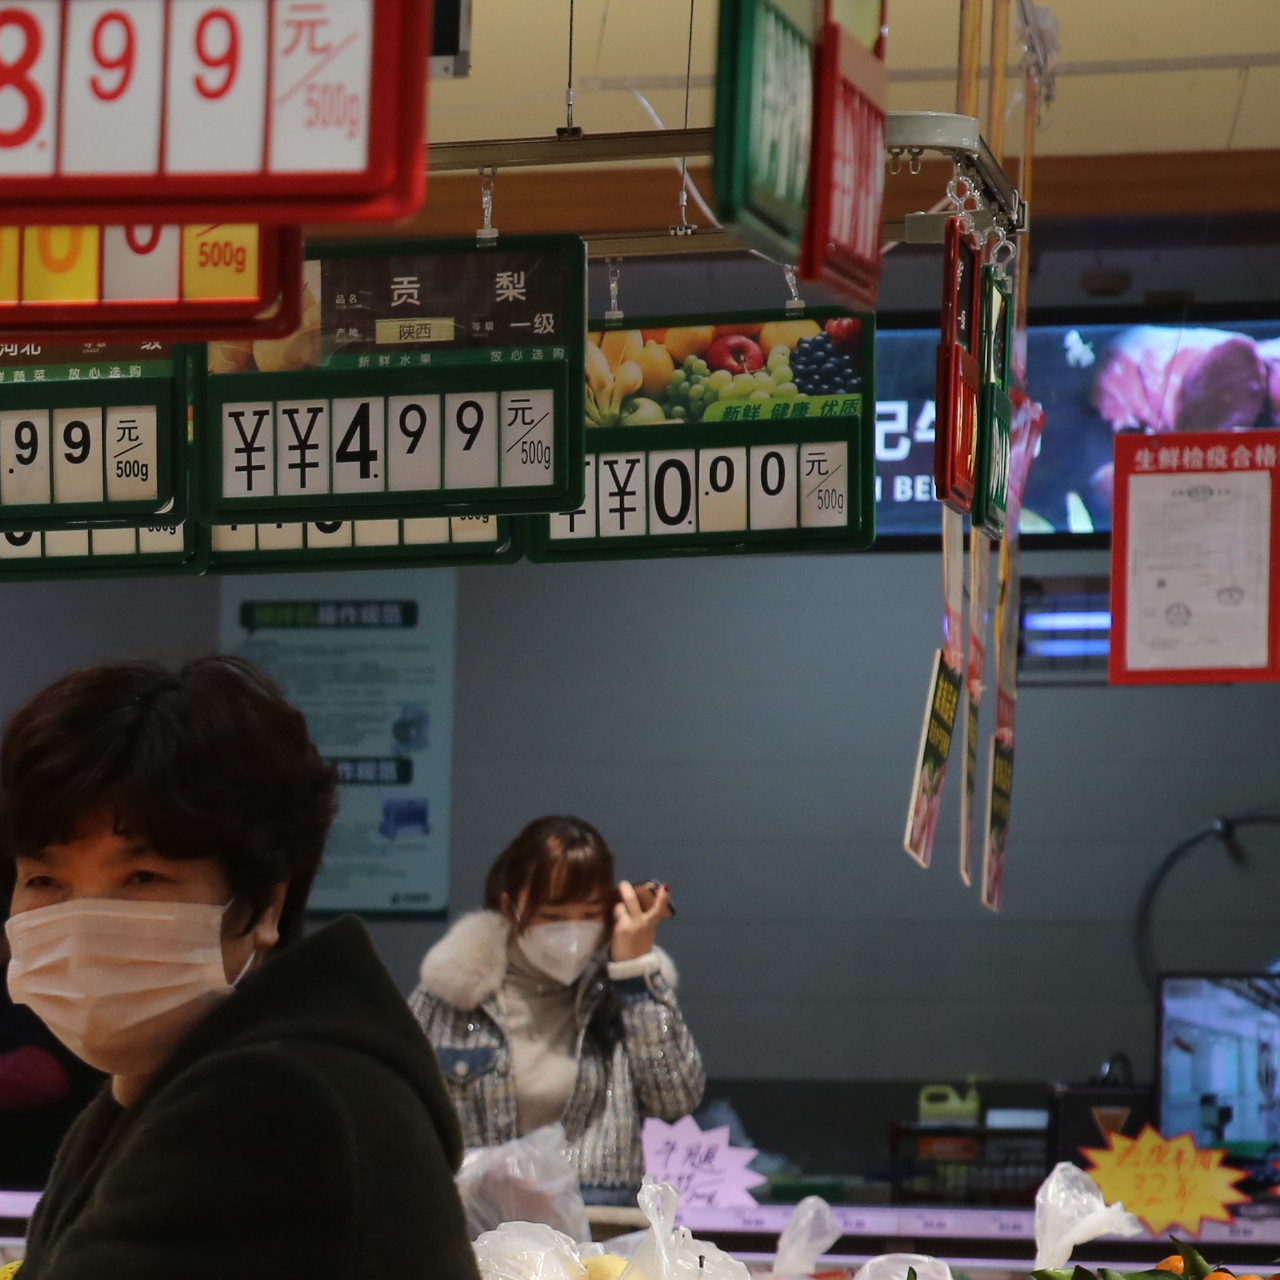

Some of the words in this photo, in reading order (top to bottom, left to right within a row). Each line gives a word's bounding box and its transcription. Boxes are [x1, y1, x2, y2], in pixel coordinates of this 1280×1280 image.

[399, 322, 432, 342] 陕西
[510, 313, 555, 335] 一级
[68, 365, 142, 379] 放心选购
[721, 403, 762, 421] 新鲜
[771, 401, 811, 419] 健康
[819, 398, 861, 416] 优质
[1134, 443, 1280, 471] 生鲜检疫合格
